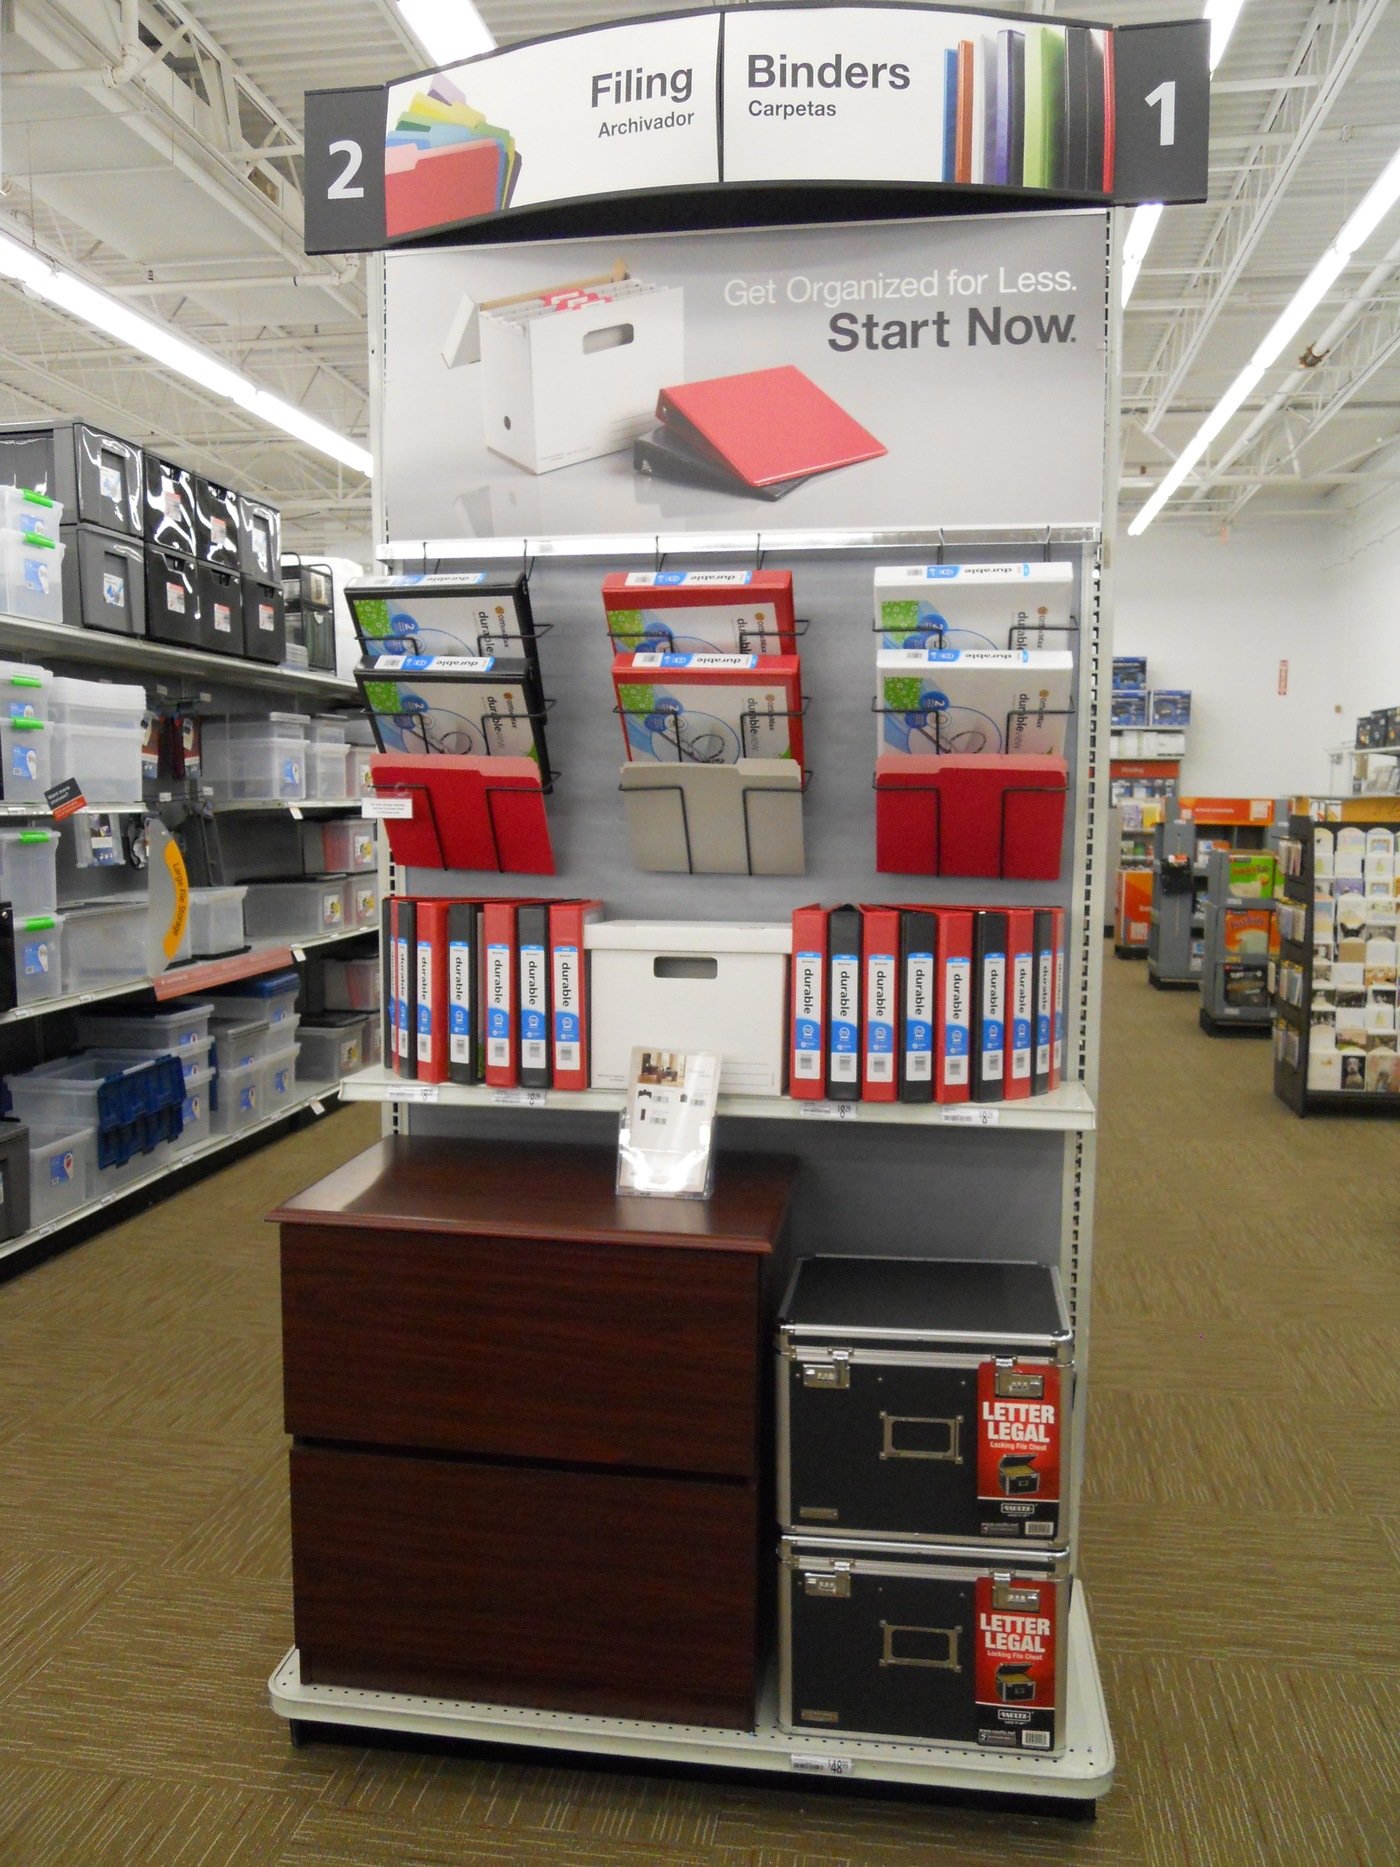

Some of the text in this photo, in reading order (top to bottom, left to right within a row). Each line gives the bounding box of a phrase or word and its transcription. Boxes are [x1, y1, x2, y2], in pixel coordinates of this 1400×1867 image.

[590, 63, 695, 110] Filing
[746, 53, 911, 92] Binders
[597, 110, 695, 139] Archivador
[748, 99, 837, 123] Carpetas
[1144, 82, 1177, 146] 1
[327, 139, 365, 201] 2
[724, 267, 1077, 309] Get Organized for Less.
[828, 306, 1076, 353] Start Now.
[1016, 611, 1028, 650] duabl
[436, 658, 479, 667] durable
[696, 656, 741, 664] durable
[172, 862, 184, 887] Large
[172, 905, 187, 936] Storage
[454, 956, 463, 1001] durable
[494, 959, 504, 1004] durable
[528, 960, 538, 1006] durable
[561, 962, 572, 1007] durable
[804, 968, 814, 1015] durable
[840, 970, 850, 1017] durable
[876, 970, 886, 1017] durable
[915, 968, 925, 1016] durable
[952, 973, 963, 1020] durable
[989, 968, 999, 1015] durable
[1018, 968, 1027, 1014] durable
[982, 1401, 1055, 1424] LETTER
[987, 1421, 1050, 1443] LEGAL
[990, 1441, 1015, 1451] Locking
[1029, 1443, 1047, 1451] Chest
[980, 1612, 1051, 1636] LETTER
[984, 1631, 1046, 1653] LEGAL
[987, 1650, 1012, 1659] Locking
[1024, 1653, 1043, 1661] Chest
[1001, 1711, 1029, 1719] VAULTZ
